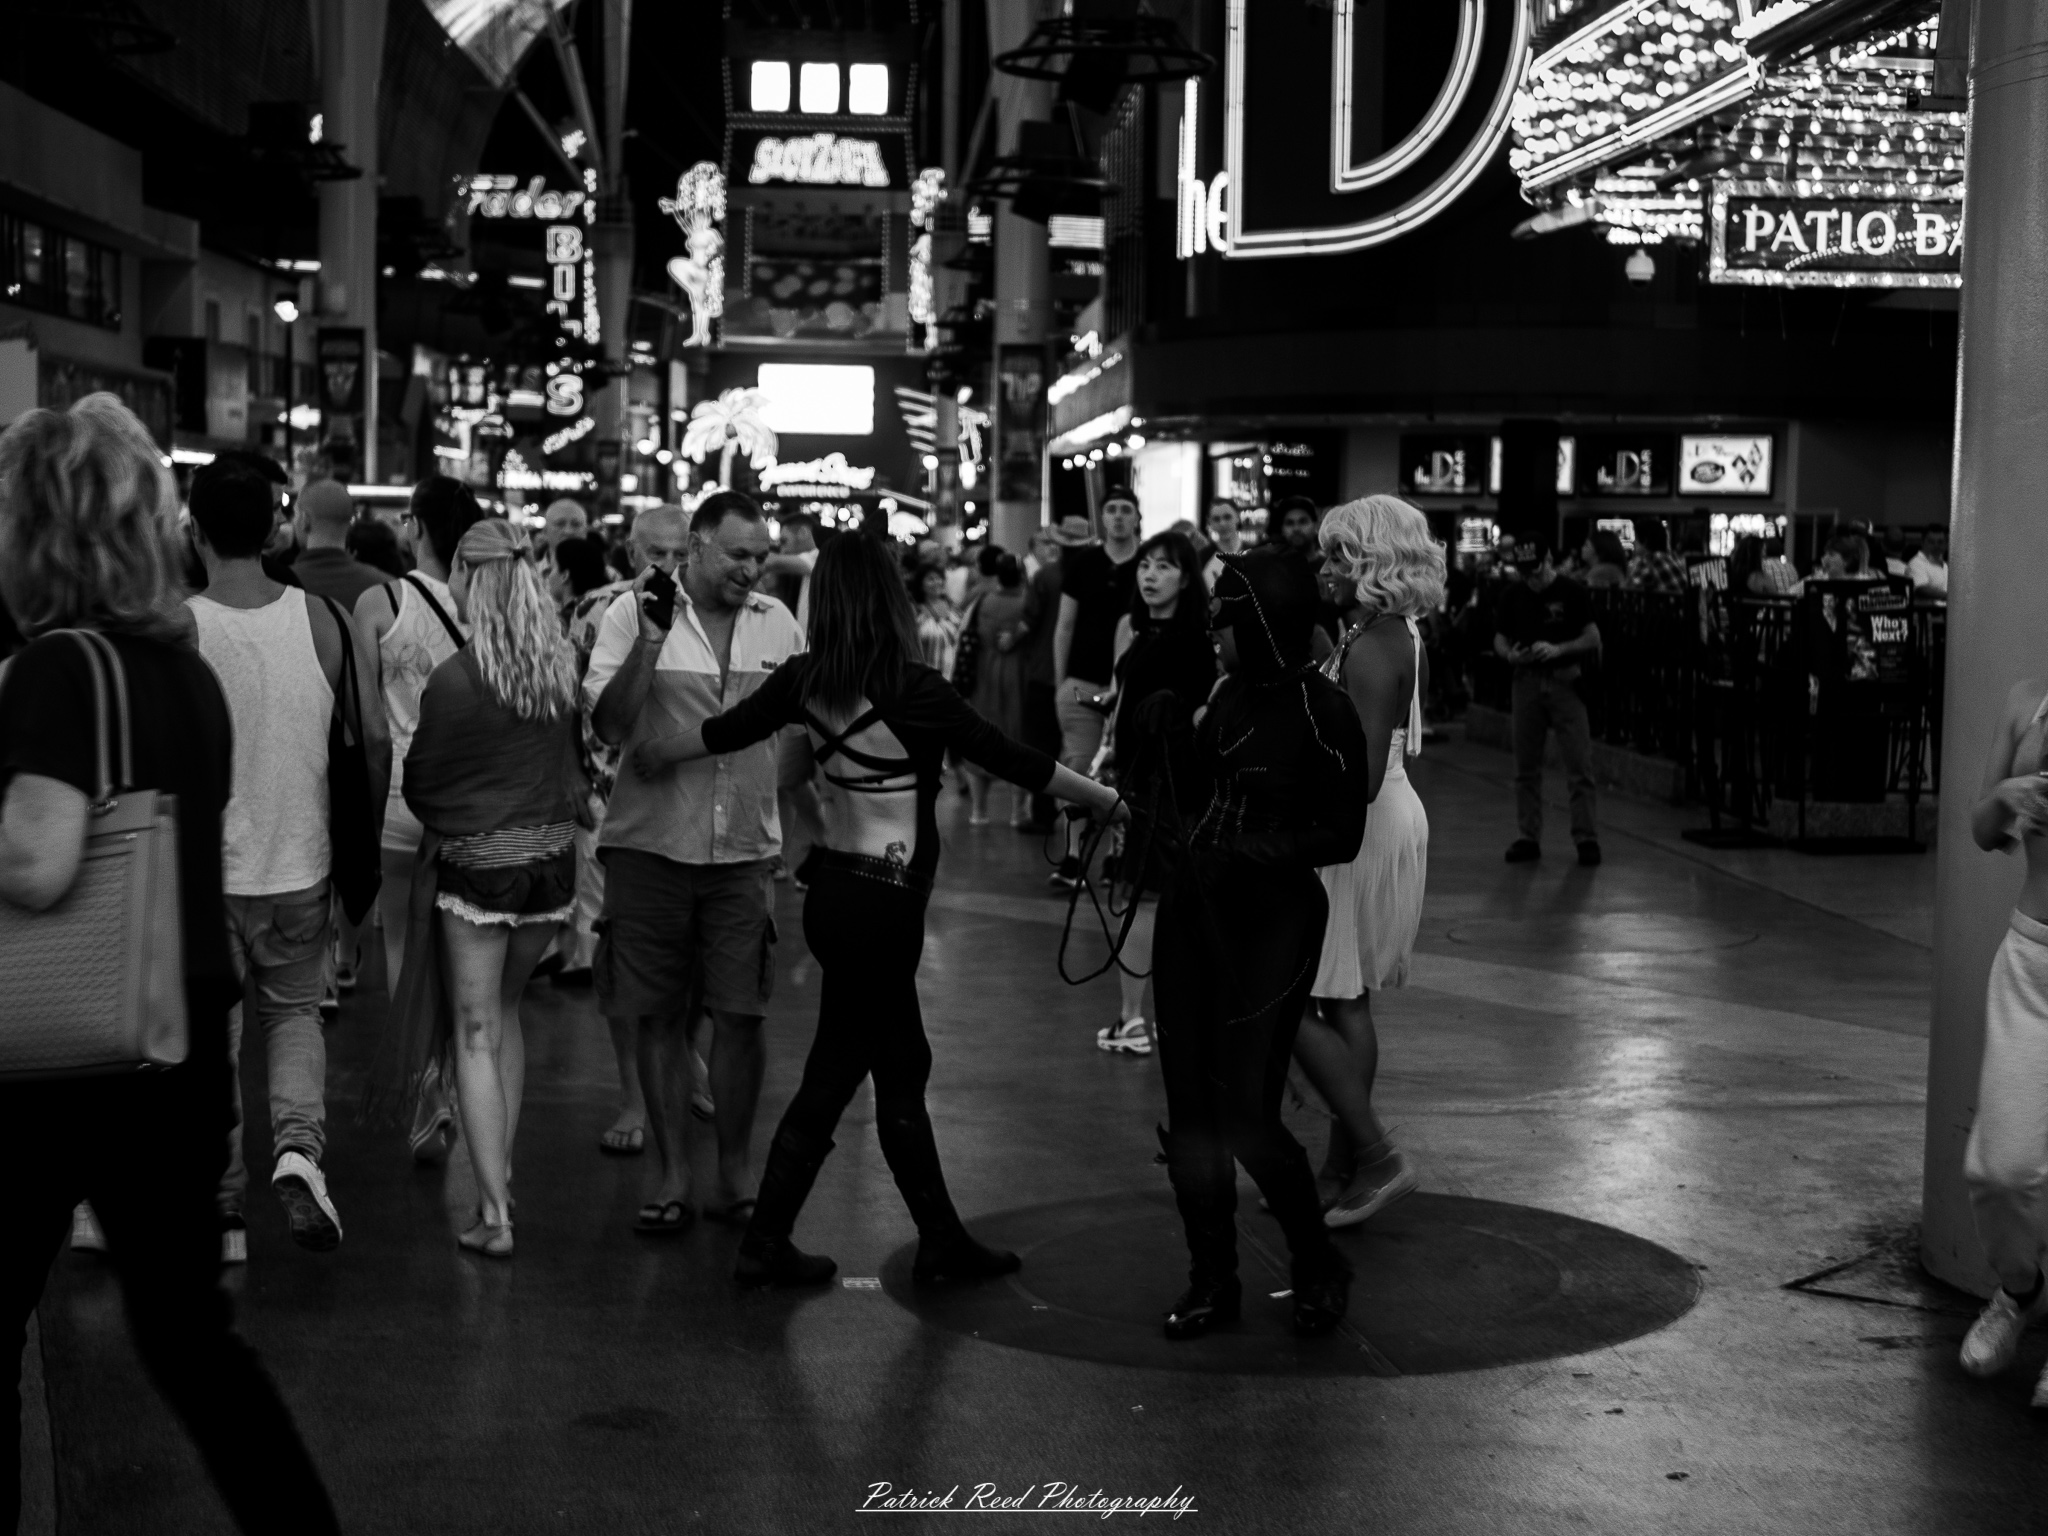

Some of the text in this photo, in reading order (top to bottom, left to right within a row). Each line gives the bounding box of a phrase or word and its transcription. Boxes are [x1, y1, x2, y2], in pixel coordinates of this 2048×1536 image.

[1222, 0, 1534, 260] D
[1742, 206, 1896, 256] PATIO
[1432, 450, 1454, 486] D
[1617, 450, 1640, 486] D
[1870, 614, 1908, 630] Who's
[1872, 629, 1908, 643] Next?
